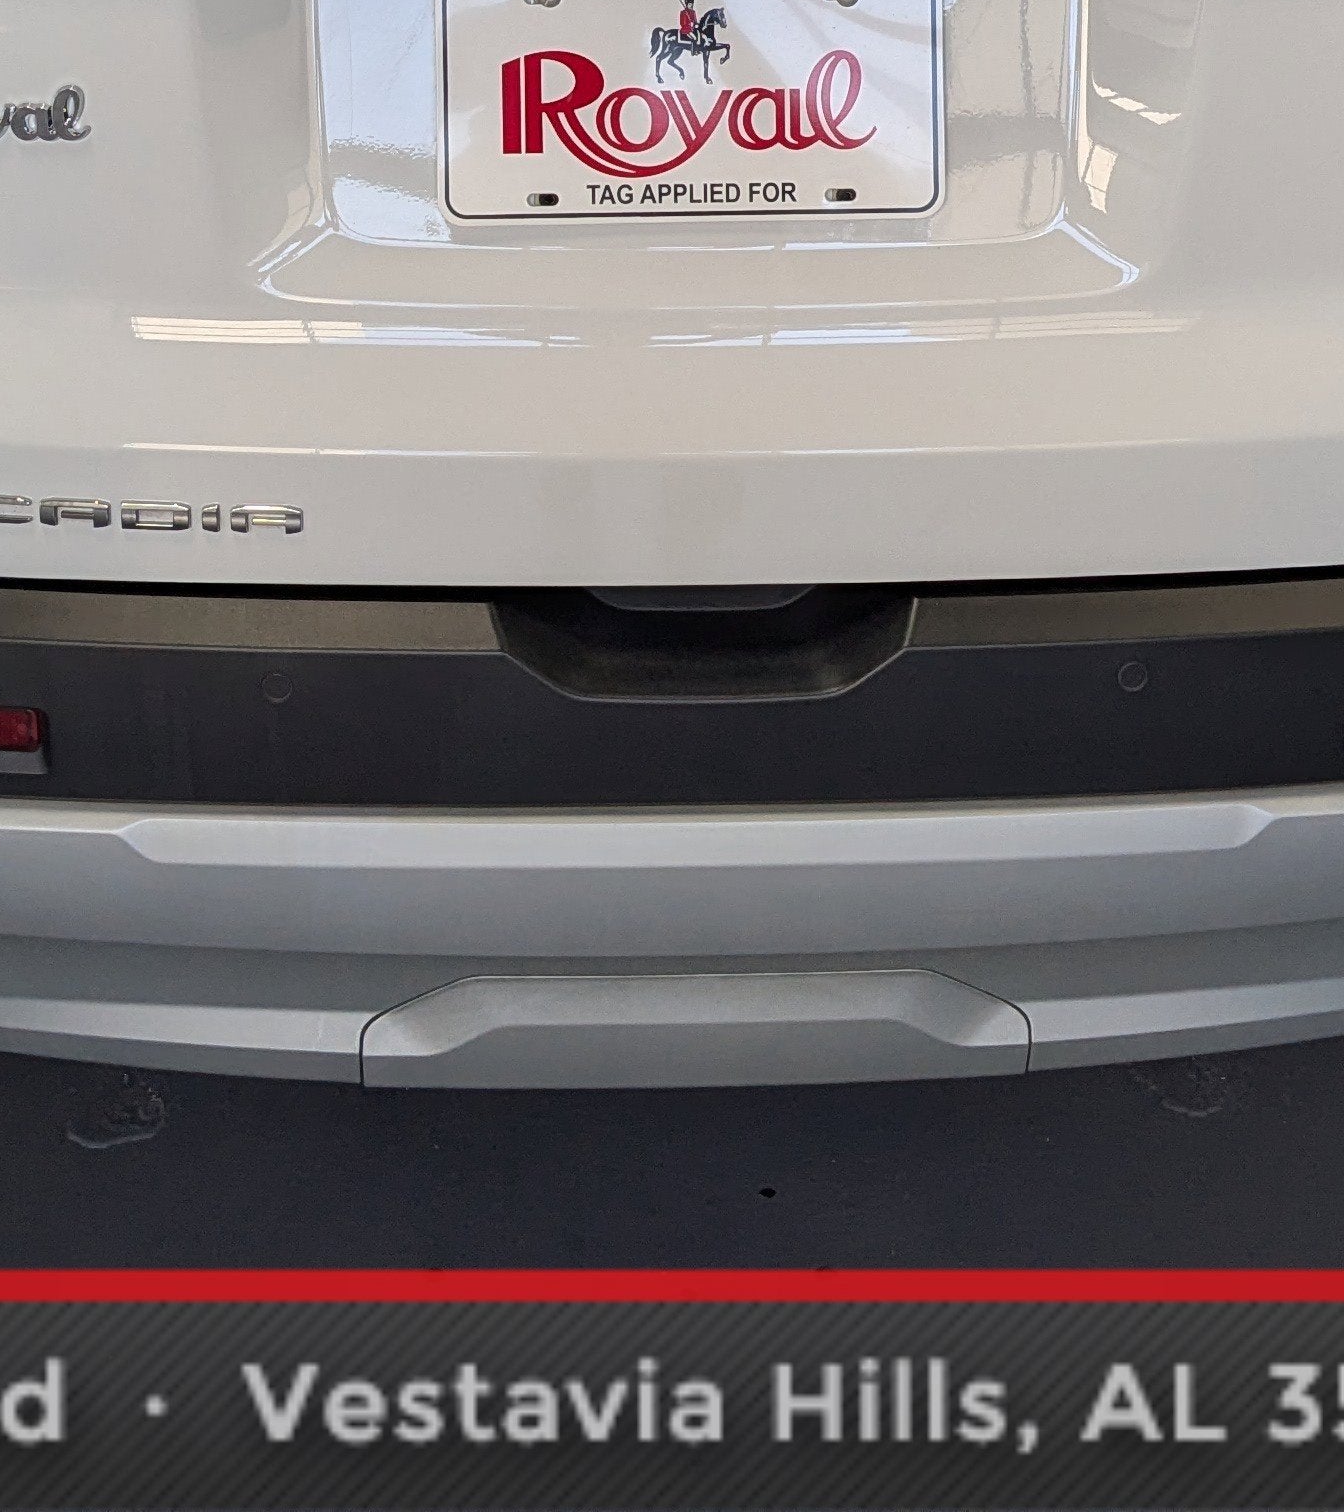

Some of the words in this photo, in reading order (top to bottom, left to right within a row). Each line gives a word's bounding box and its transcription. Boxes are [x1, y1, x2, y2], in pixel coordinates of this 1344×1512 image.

[501, 49, 877, 178] Royal
[586, 183, 635, 206] TAG
[639, 182, 742, 205] APPLIED
[747, 181, 798, 203] FOR
